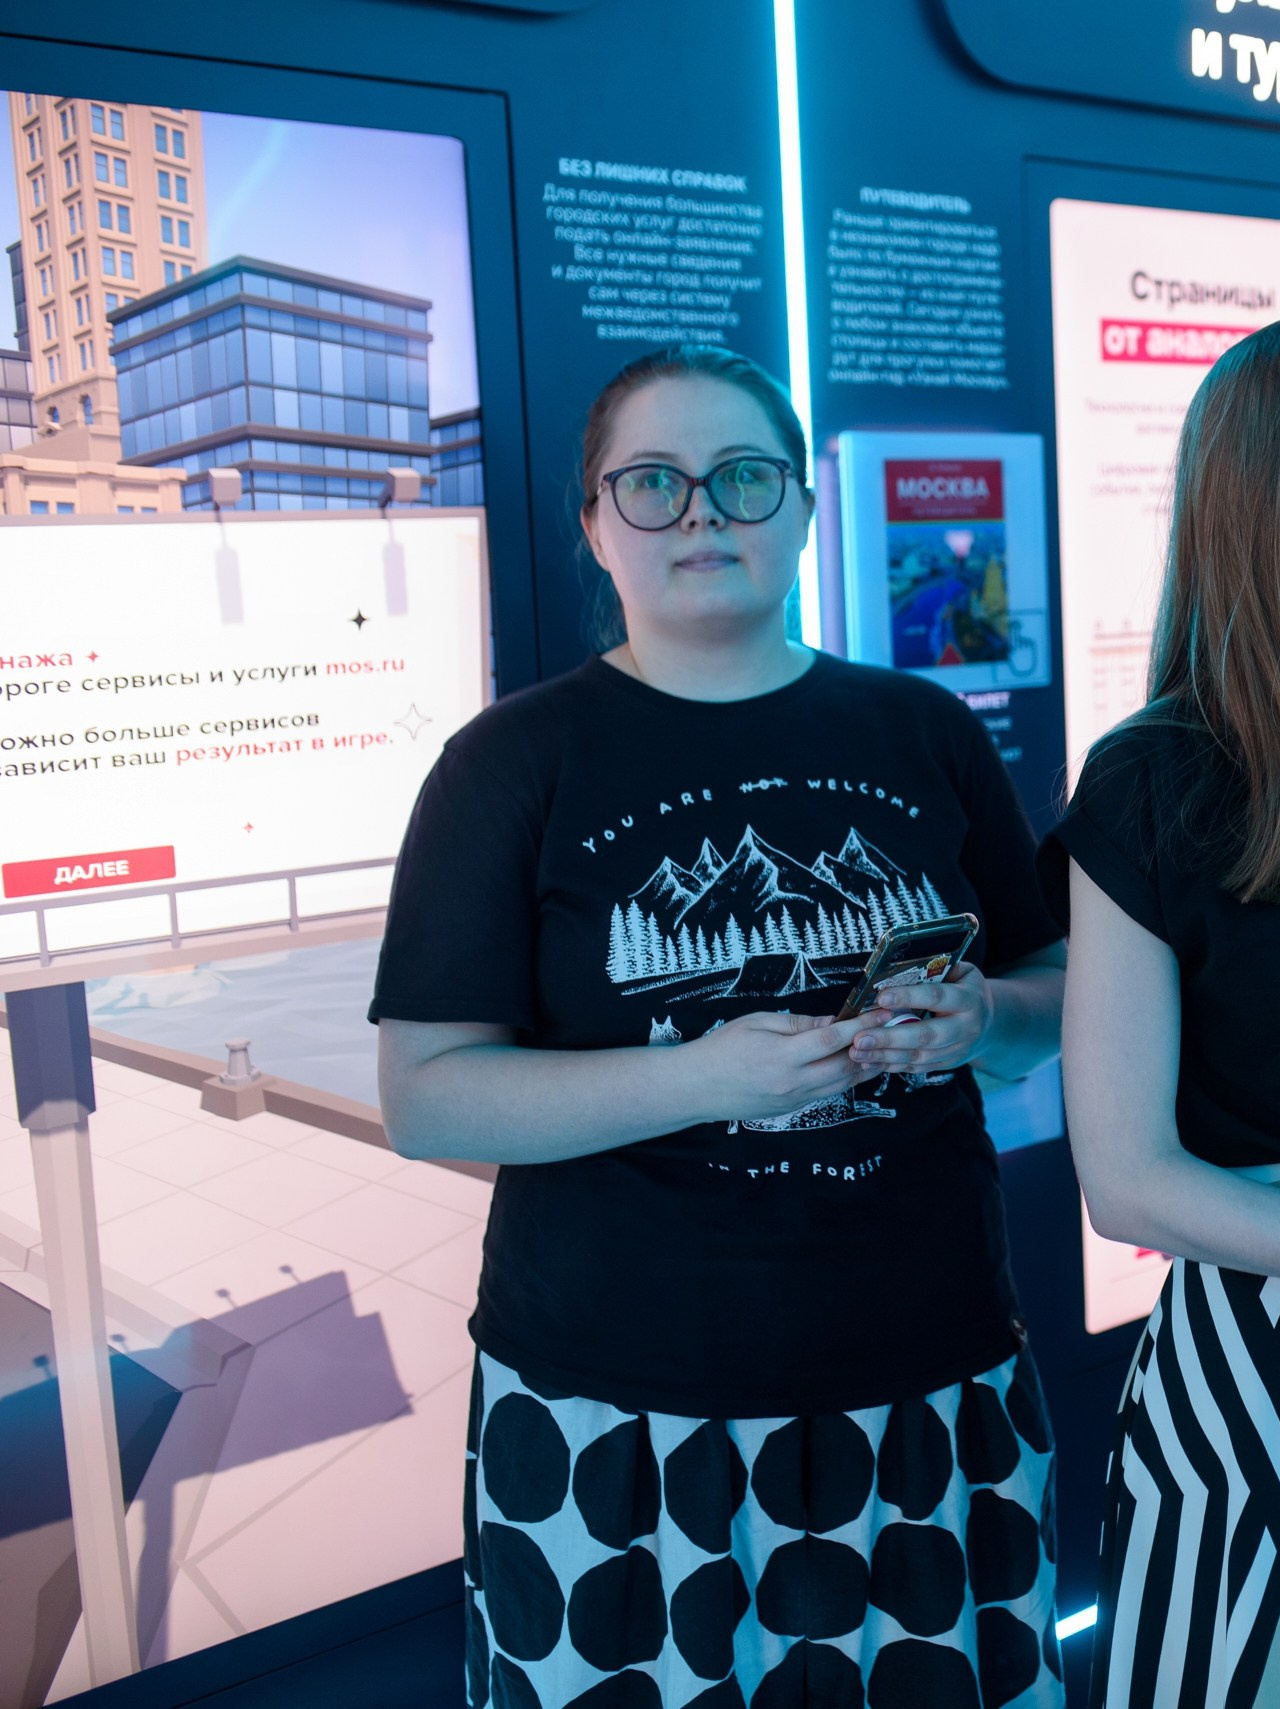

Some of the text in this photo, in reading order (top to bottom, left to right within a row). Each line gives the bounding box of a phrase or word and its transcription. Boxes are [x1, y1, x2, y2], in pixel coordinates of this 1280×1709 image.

[1191, 27, 1223, 80] и
[559, 158, 747, 192] БЕЗ ЛИШНИХ СПРАВОК
[543, 183, 763, 220] Для получения большинства
[546, 206, 763, 238] городских услуг достаточно
[554, 226, 610, 246] подать
[574, 244, 742, 272] Все нужные сведения
[551, 264, 563, 279] и
[565, 264, 653, 284] документы
[655, 270, 700, 289] город
[1130, 270, 1275, 311] Страницы
[588, 285, 619, 301] сам
[622, 288, 668, 306] через
[582, 304, 740, 327] межведомственного
[1104, 325, 1142, 356] от
[897, 476, 990, 499] МОСКВА
[0, 658, 405, 701] роге сервисы и услуги mos.ru
[85, 723, 190, 744] больше
[200, 714, 319, 736] сервисов
[112, 751, 166, 768] ваш
[176, 739, 302, 765] результат
[311, 737, 324, 751] в
[334, 732, 394, 750] игре.
[582, 815, 634, 853] YOU
[659, 788, 713, 815] ARE
[807, 777, 920, 818] WELCOME
[54, 859, 130, 885] ДАЛЕЕ
[747, 1161, 790, 1179] THE
[812, 1155, 882, 1181] FOREST
